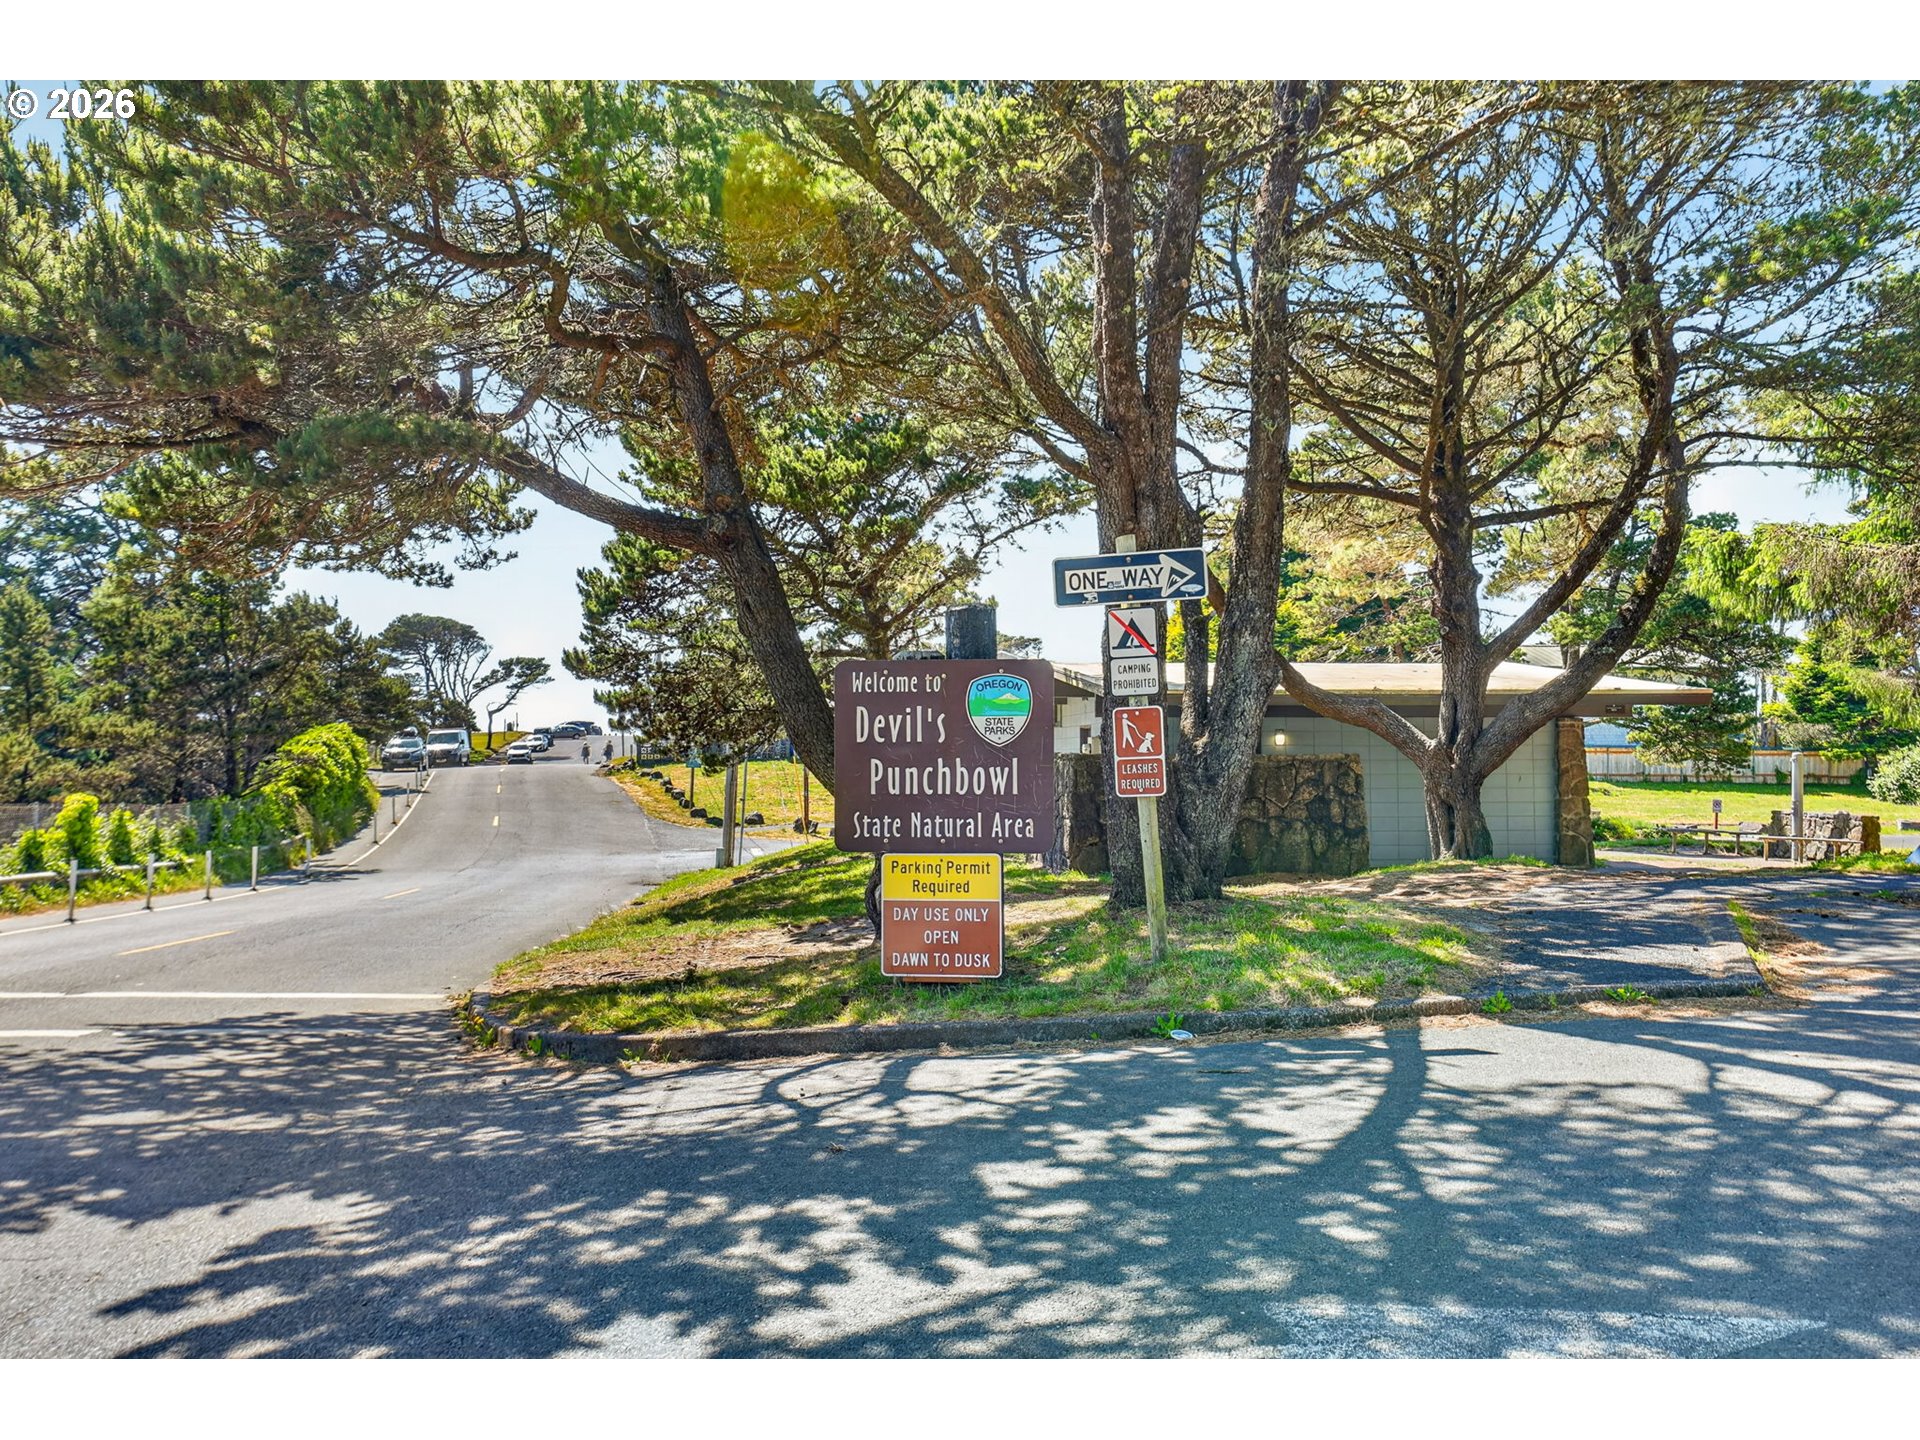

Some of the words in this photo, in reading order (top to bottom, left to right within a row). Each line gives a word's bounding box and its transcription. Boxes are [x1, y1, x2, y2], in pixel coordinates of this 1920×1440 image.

[1069, 571, 1107, 591] ONE
[1122, 567, 1164, 588] WAY
[1117, 663, 1152, 675] CAMPING
[852, 671, 918, 693] Welcome
[925, 674, 941, 693] to
[976, 679, 1023, 692] OREGON
[1113, 677, 1157, 690] PROHIBITED
[856, 705, 946, 743] Devil's
[985, 717, 1014, 726] STATE
[984, 726, 1016, 736] PARKS
[870, 757, 1019, 796] Punchbowl
[1122, 763, 1158, 775] LEASHES
[1121, 778, 1161, 790] REQUIRED
[853, 811, 901, 839] State
[910, 811, 982, 838] Natural
[991, 812, 1035, 839] Area
[891, 860, 942, 878] Parking
[946, 860, 991, 875] Permit
[912, 879, 970, 896] Required
[893, 907, 919, 922] DAY
[924, 907, 950, 922] USE
[955, 907, 989, 922] ONLY
[924, 930, 959, 944] OPEN
[892, 953, 928, 967] DAWN
[933, 953, 950, 967] TO
[955, 953, 991, 968] DUSK
